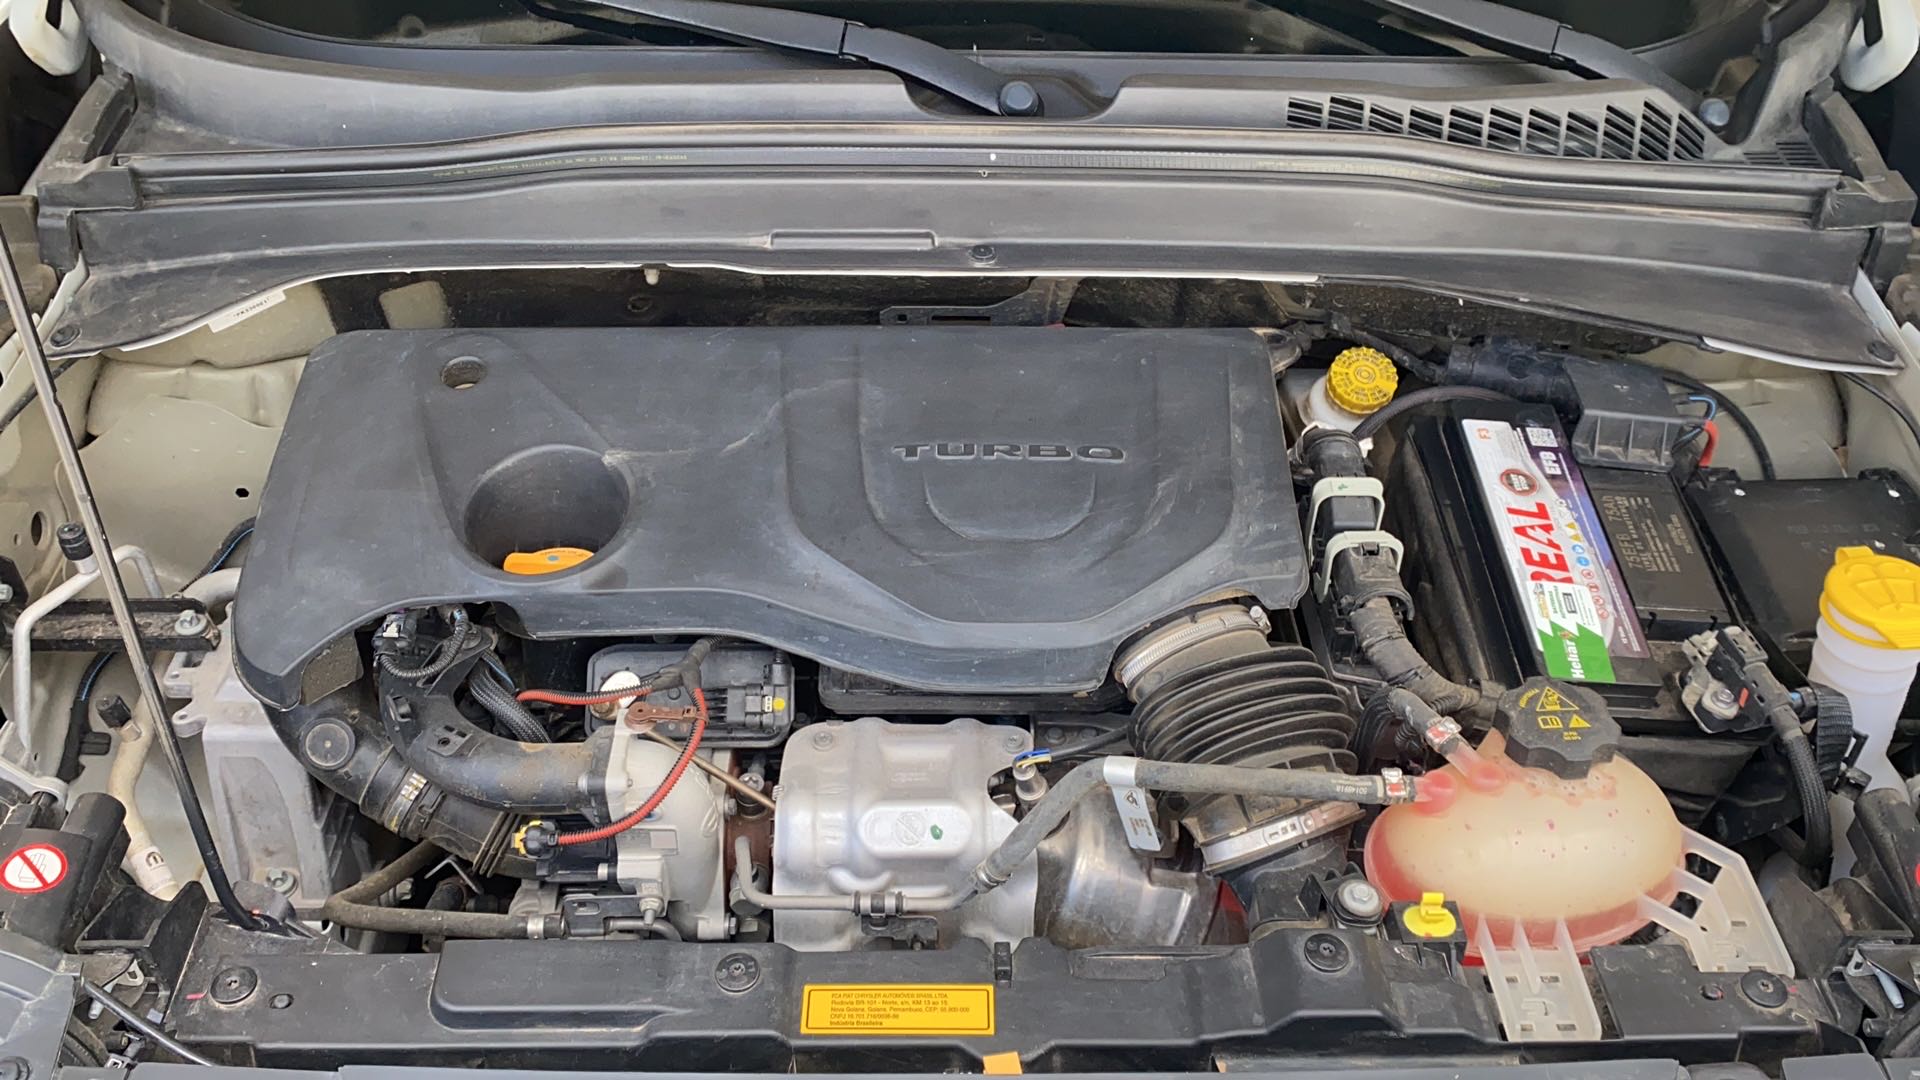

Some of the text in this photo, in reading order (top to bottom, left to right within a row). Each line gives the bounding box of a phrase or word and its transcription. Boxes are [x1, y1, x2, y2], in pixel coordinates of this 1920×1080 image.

[892, 443, 1126, 464] TURBO
[1539, 450, 1563, 476] EFB
[1602, 495, 1623, 522] 75Ah
[1505, 501, 1576, 585] REAL
[1615, 532, 1645, 569] 75EFB
[1565, 639, 1586, 680] Heliar
